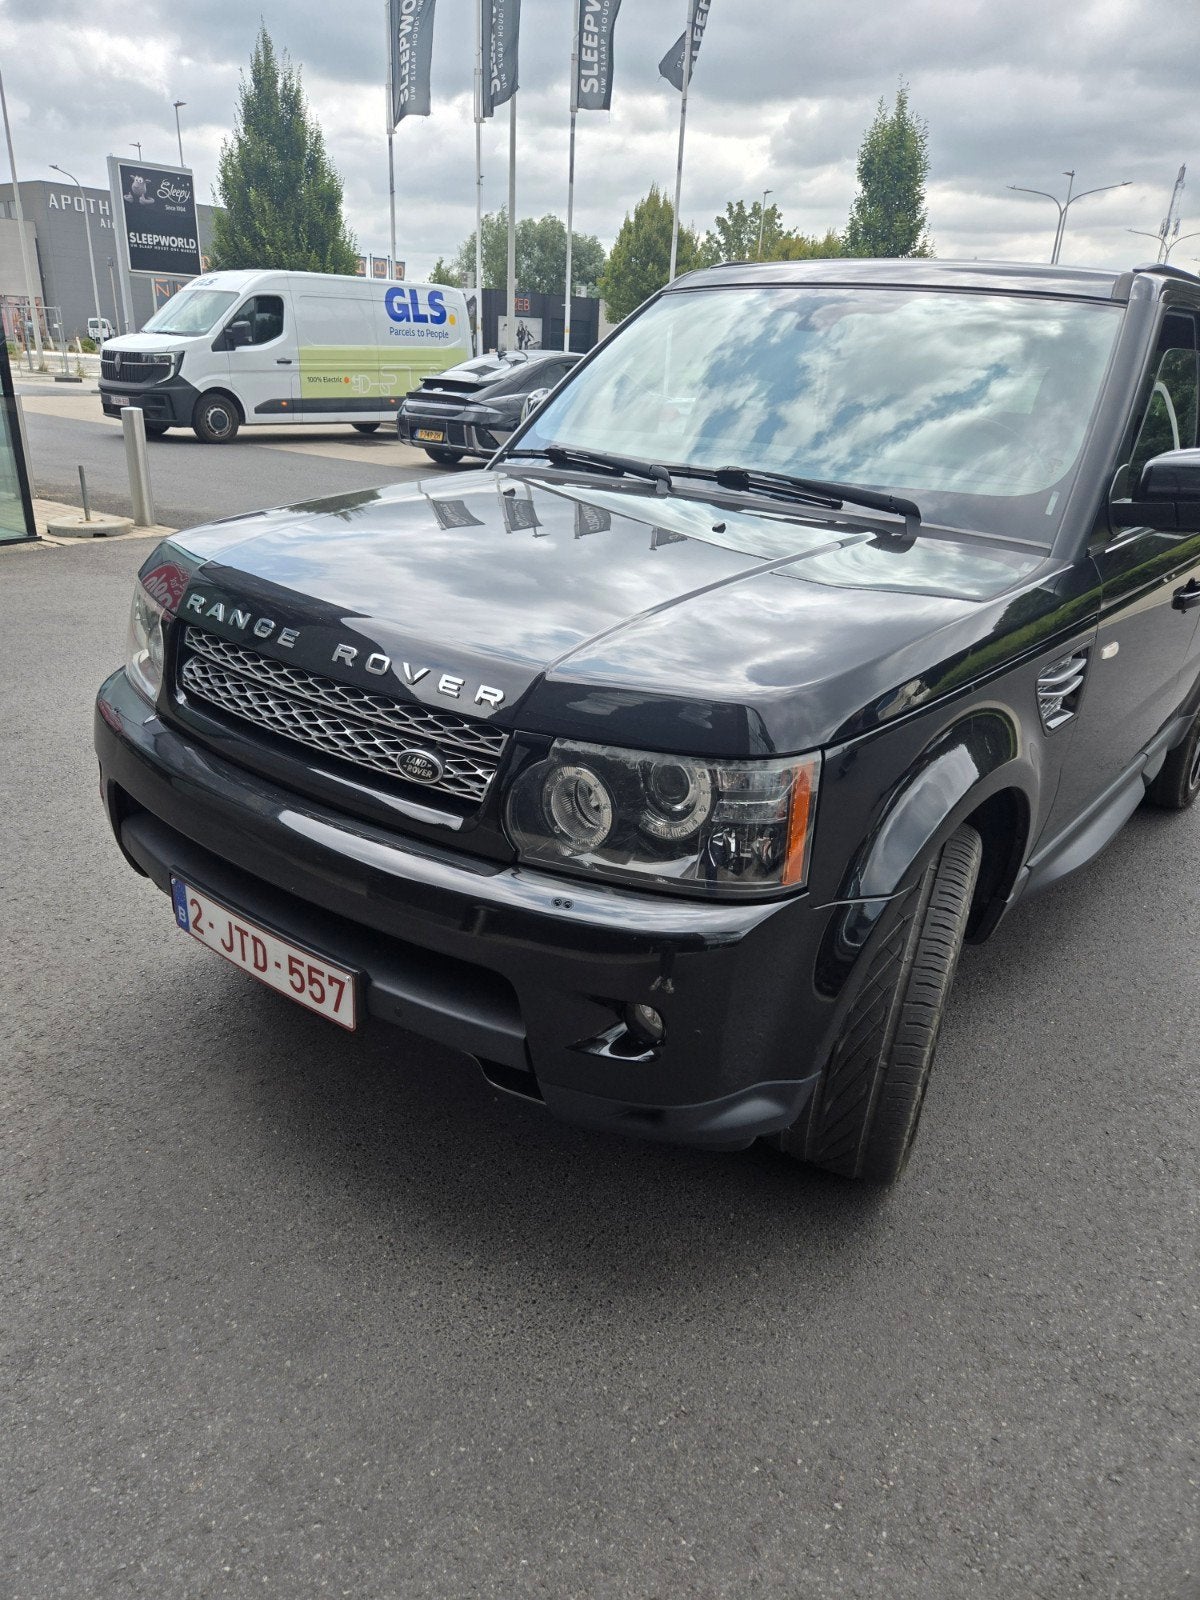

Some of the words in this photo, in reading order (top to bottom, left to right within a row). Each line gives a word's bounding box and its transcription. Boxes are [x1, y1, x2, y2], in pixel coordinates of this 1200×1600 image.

[601, 77, 607, 94] UW
[156, 178, 191, 204] Sleepy
[129, 232, 197, 250] SLEEPWORLD
[389, 326, 416, 338] Parcels
[417, 328, 425, 338] to
[425, 328, 450, 341] People
[185, 592, 301, 648] RANGE
[331, 642, 506, 708] ROVER
[405, 755, 428, 768] LAND
[407, 764, 433, 779] ROVER
[177, 905, 188, 924] B
[189, 898, 347, 1013] 2-JTD-557
